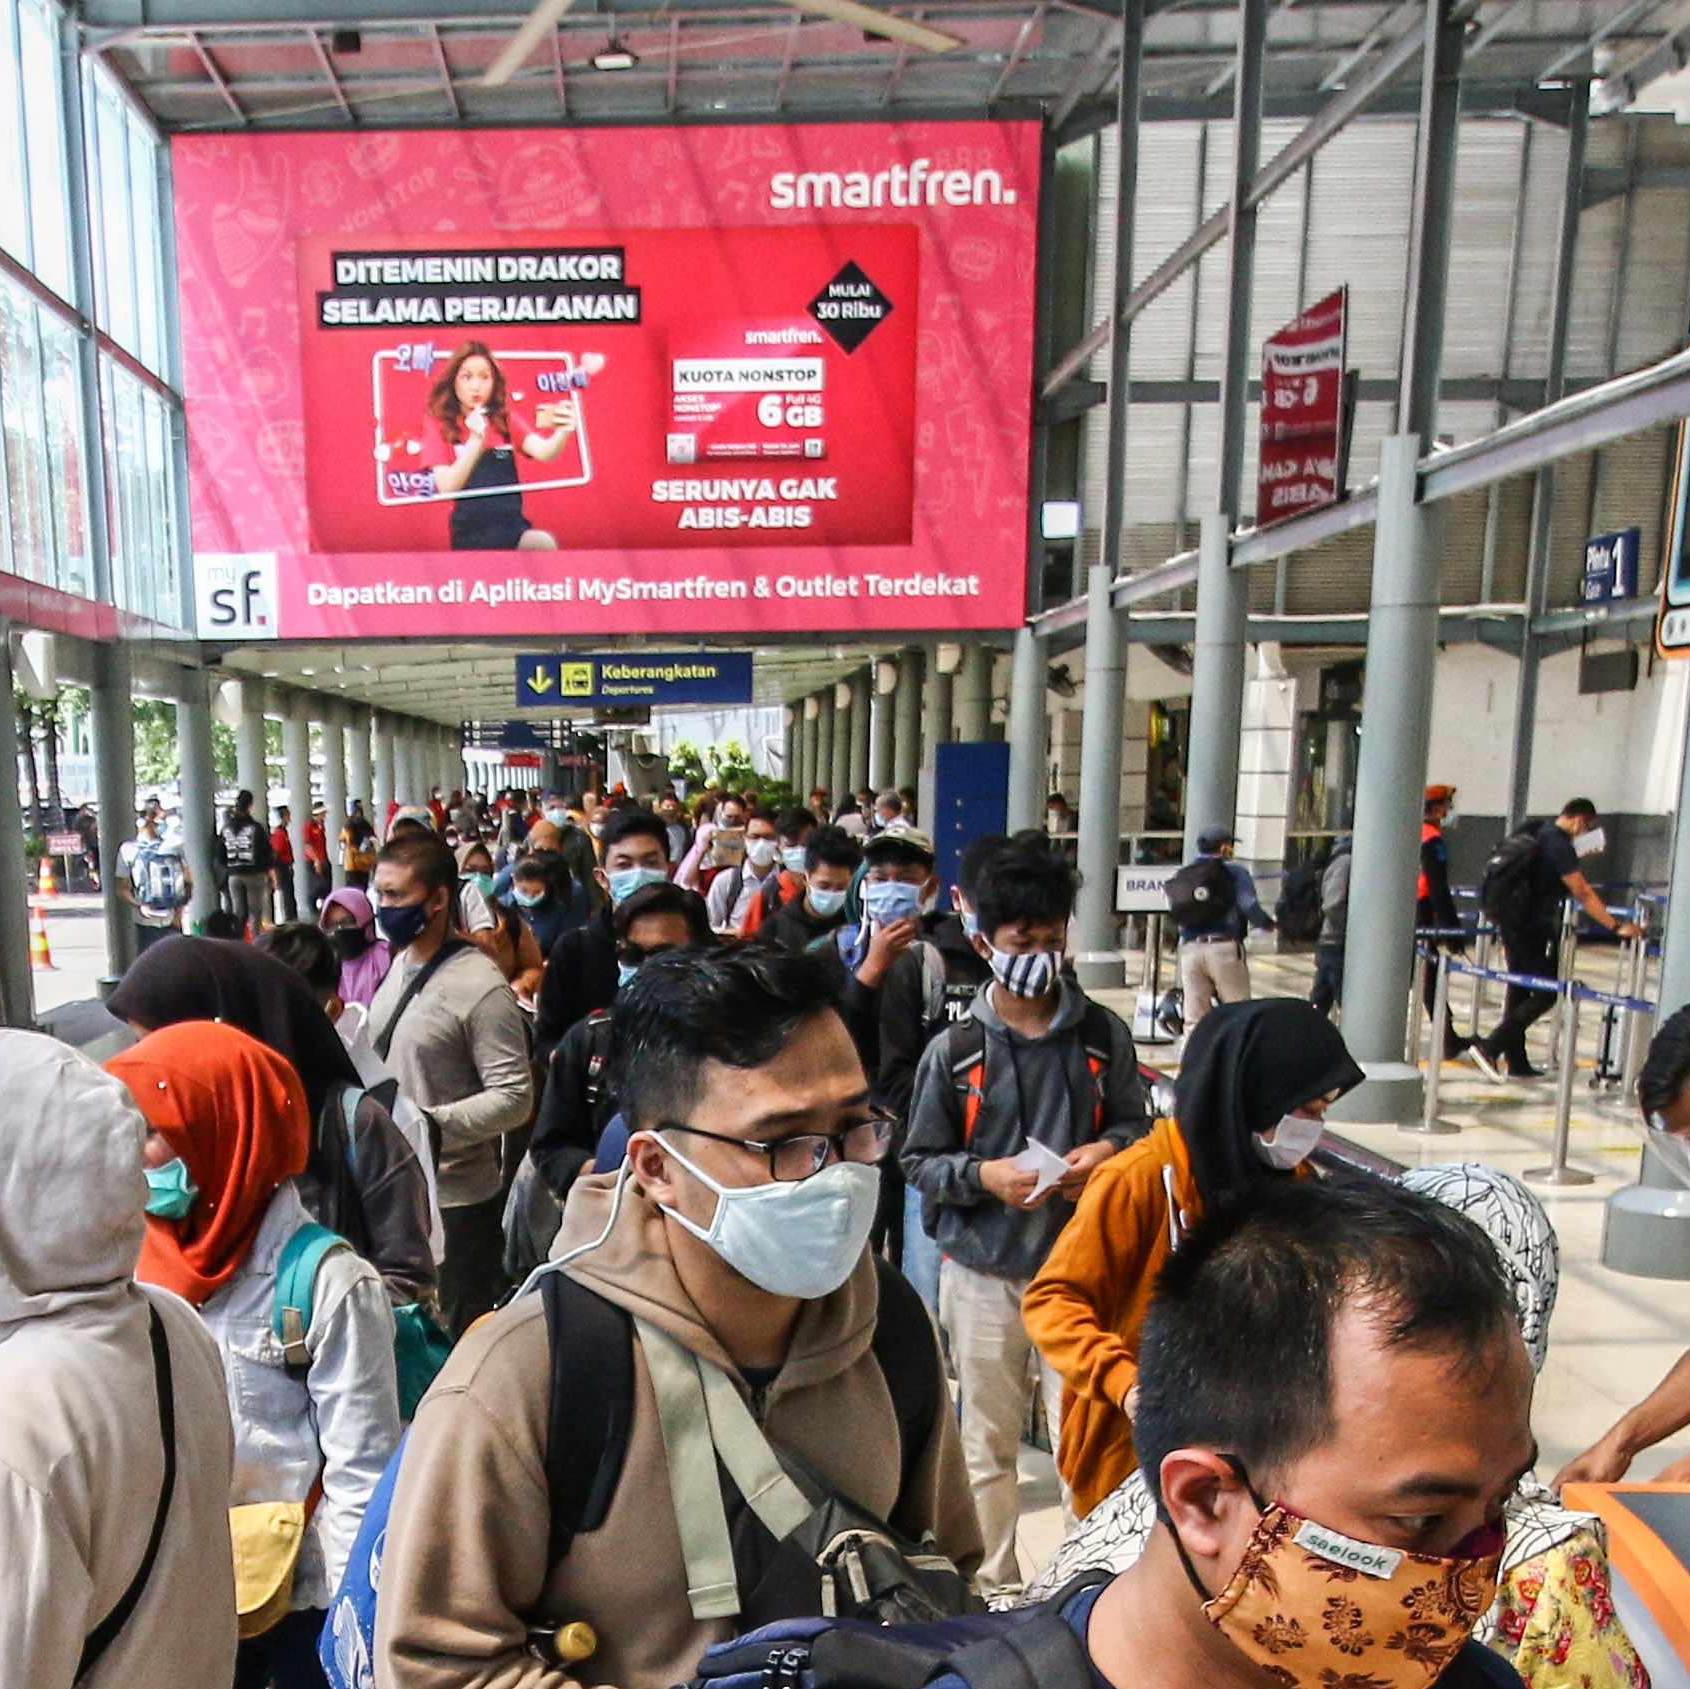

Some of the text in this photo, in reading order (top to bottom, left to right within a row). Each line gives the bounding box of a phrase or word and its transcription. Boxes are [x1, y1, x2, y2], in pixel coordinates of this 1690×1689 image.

[770, 157, 1017, 209] smartfren.
[336, 254, 621, 285] DITEMENIN DRAKOR
[828, 283, 872, 298] MULAI
[321, 294, 638, 324] SELAMA PERJALANAN
[817, 301, 882, 319] 30 Ribu
[744, 327, 823, 345] smartfren.
[678, 369, 818, 384] KUOTA NONSTOP
[757, 394, 784, 428] 6
[785, 406, 823, 428] GB
[651, 478, 837, 502] SERUNYA GAK
[677, 506, 812, 529] ABIS-ABIS
[1612, 536, 1625, 597] 1
[307, 572, 979, 609] Dapatkan di Aplikasi MySmartfren & Outlet Terdekat
[601, 664, 717, 682] Keberangkatan
[601, 685, 655, 696] Departures
[1306, 1532, 1389, 1571] saelook
